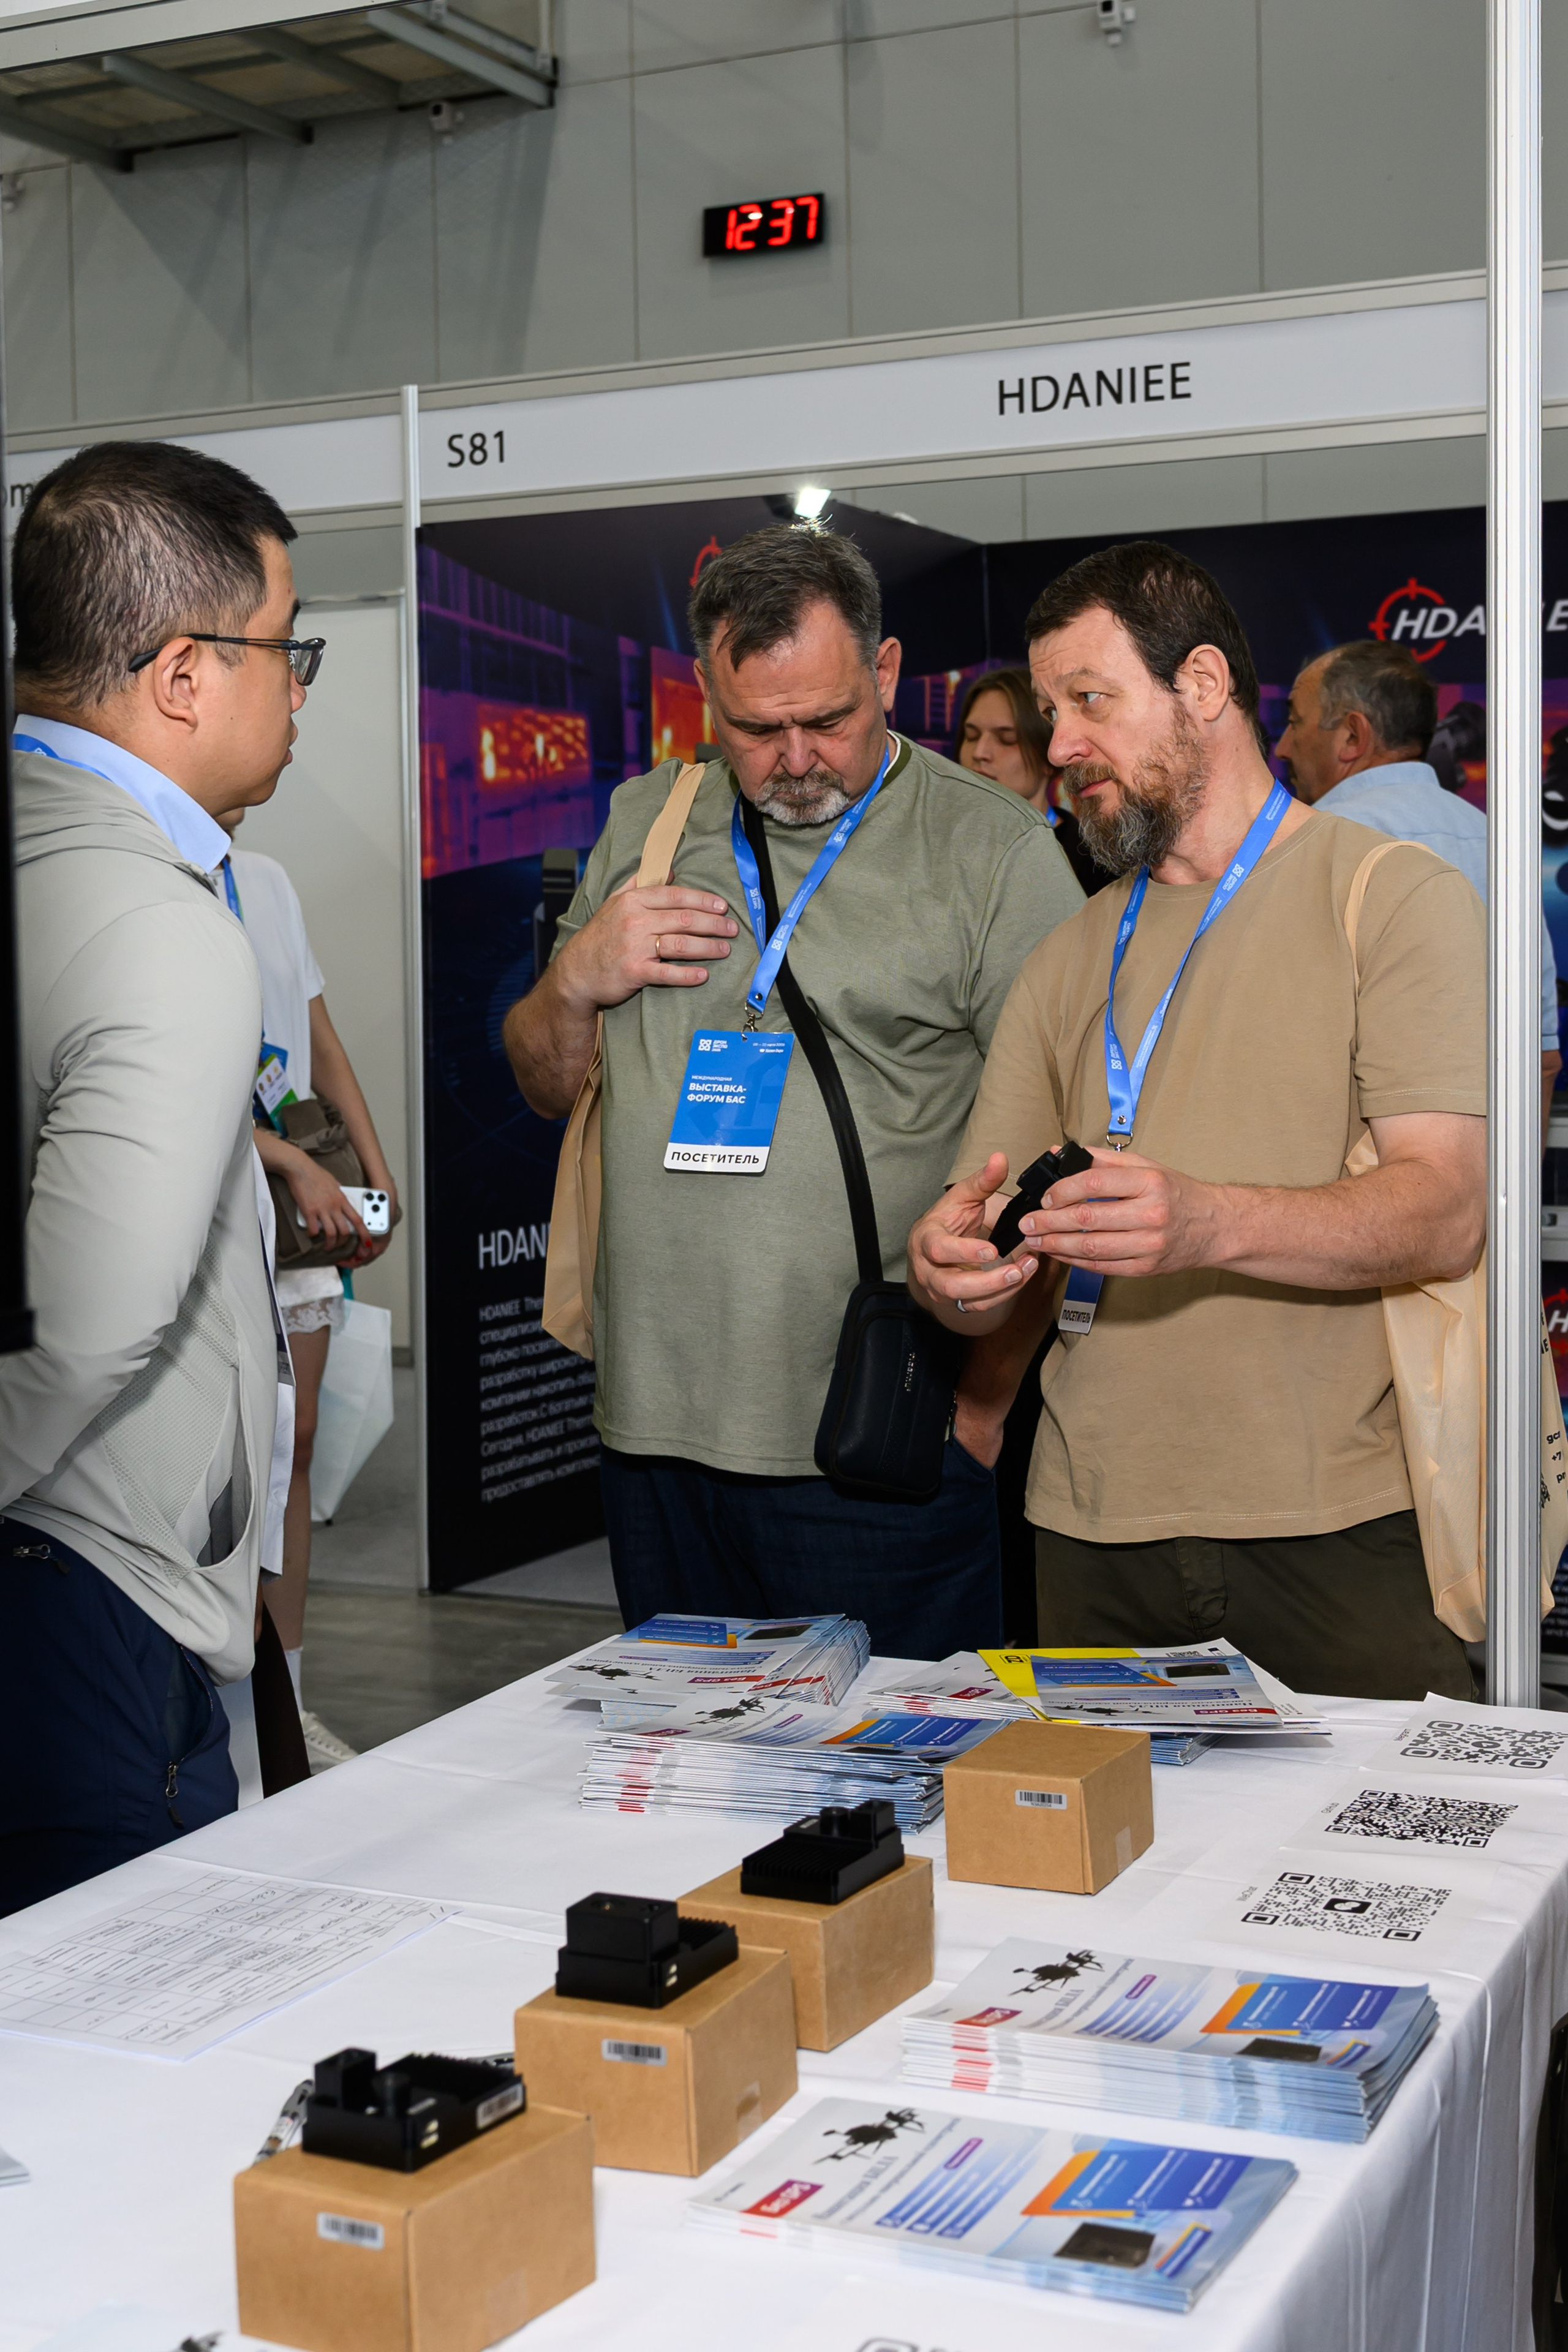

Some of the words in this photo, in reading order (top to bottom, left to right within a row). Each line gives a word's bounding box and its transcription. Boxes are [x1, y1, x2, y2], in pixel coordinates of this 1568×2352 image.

[998, 361, 1191, 416] HDANIEE
[447, 430, 504, 468] S81
[689, 1083, 747, 1093] ВЫСТАВКА-
[687, 1094, 725, 1103] ФОРУМ
[726, 1095, 746, 1104] БАС
[671, 1152, 760, 1164] ПОСЕТИТЕЛЬ
